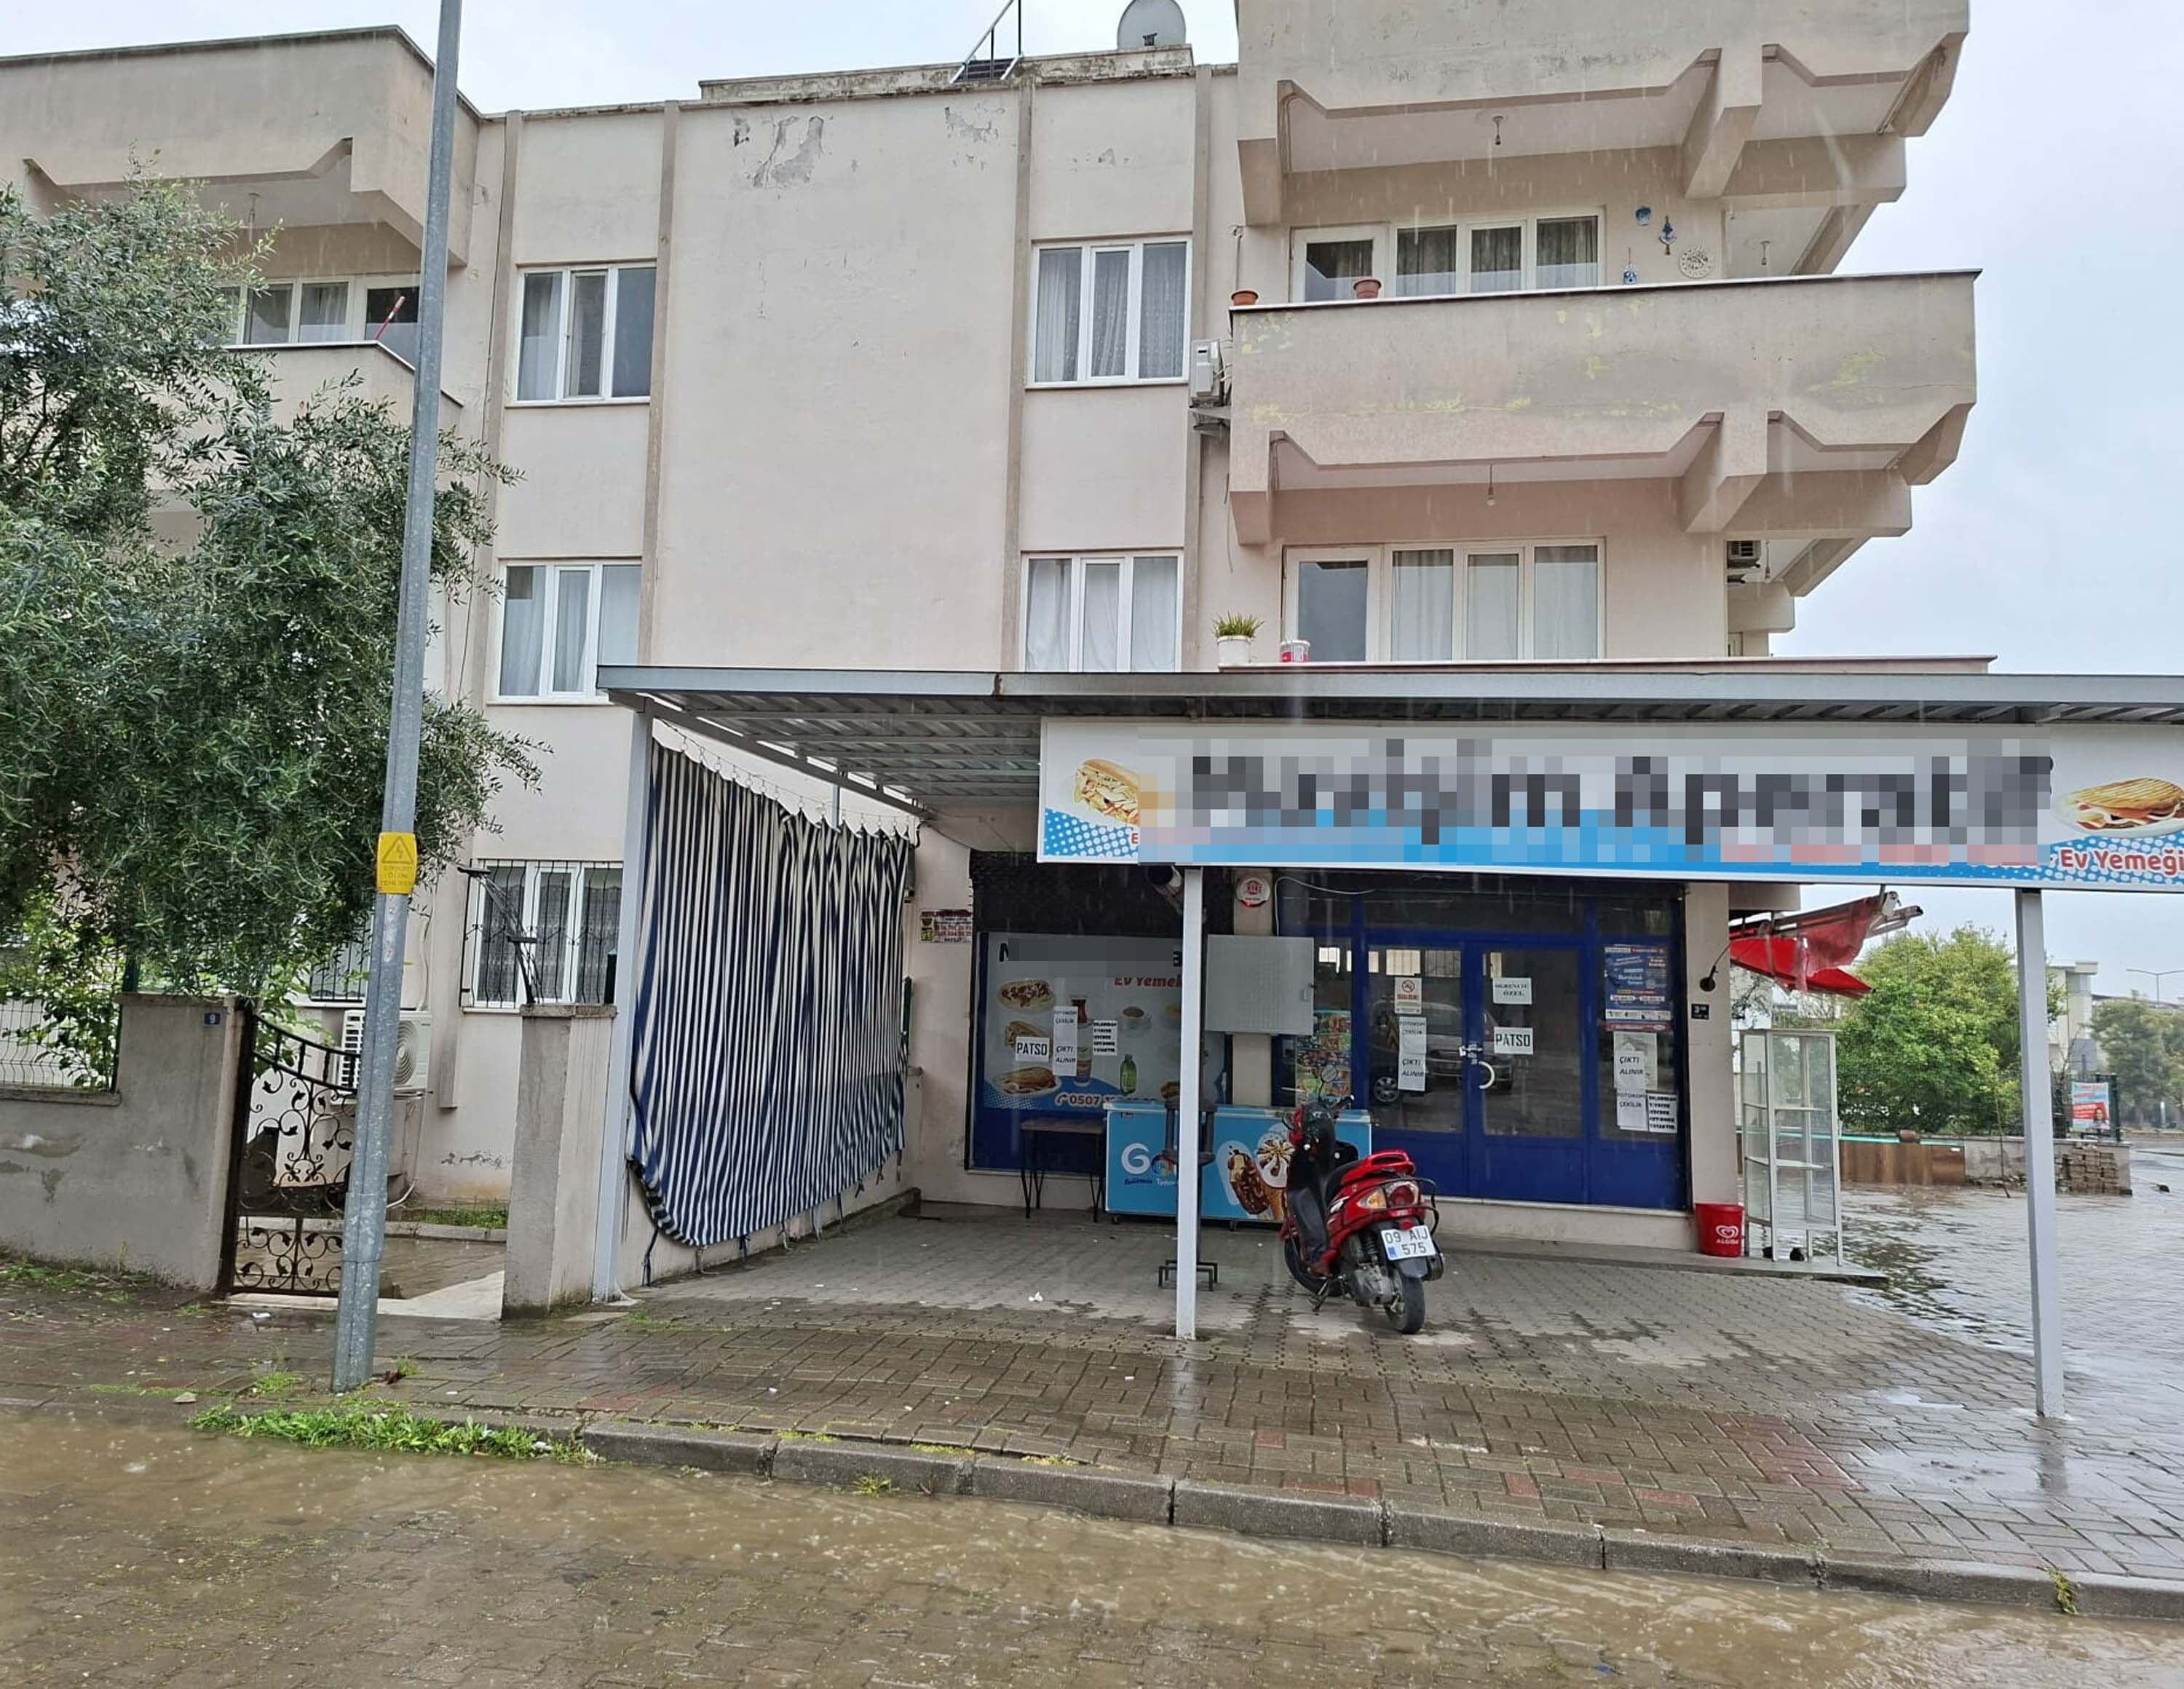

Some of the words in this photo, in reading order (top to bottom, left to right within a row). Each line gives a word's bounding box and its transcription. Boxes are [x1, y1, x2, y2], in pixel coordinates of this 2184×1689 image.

[2060, 849, 2088, 869] Ev
[210, 1013, 216, 1024] 9
[1495, 1033, 1531, 1047] PATSO
[1016, 1042, 1048, 1056] PATSO
[1069, 1096, 1100, 1106] 0507
[1384, 1231, 1401, 1243] 09
[1409, 1227, 1428, 1241] AIJ
[1401, 1242, 1427, 1255] 575
